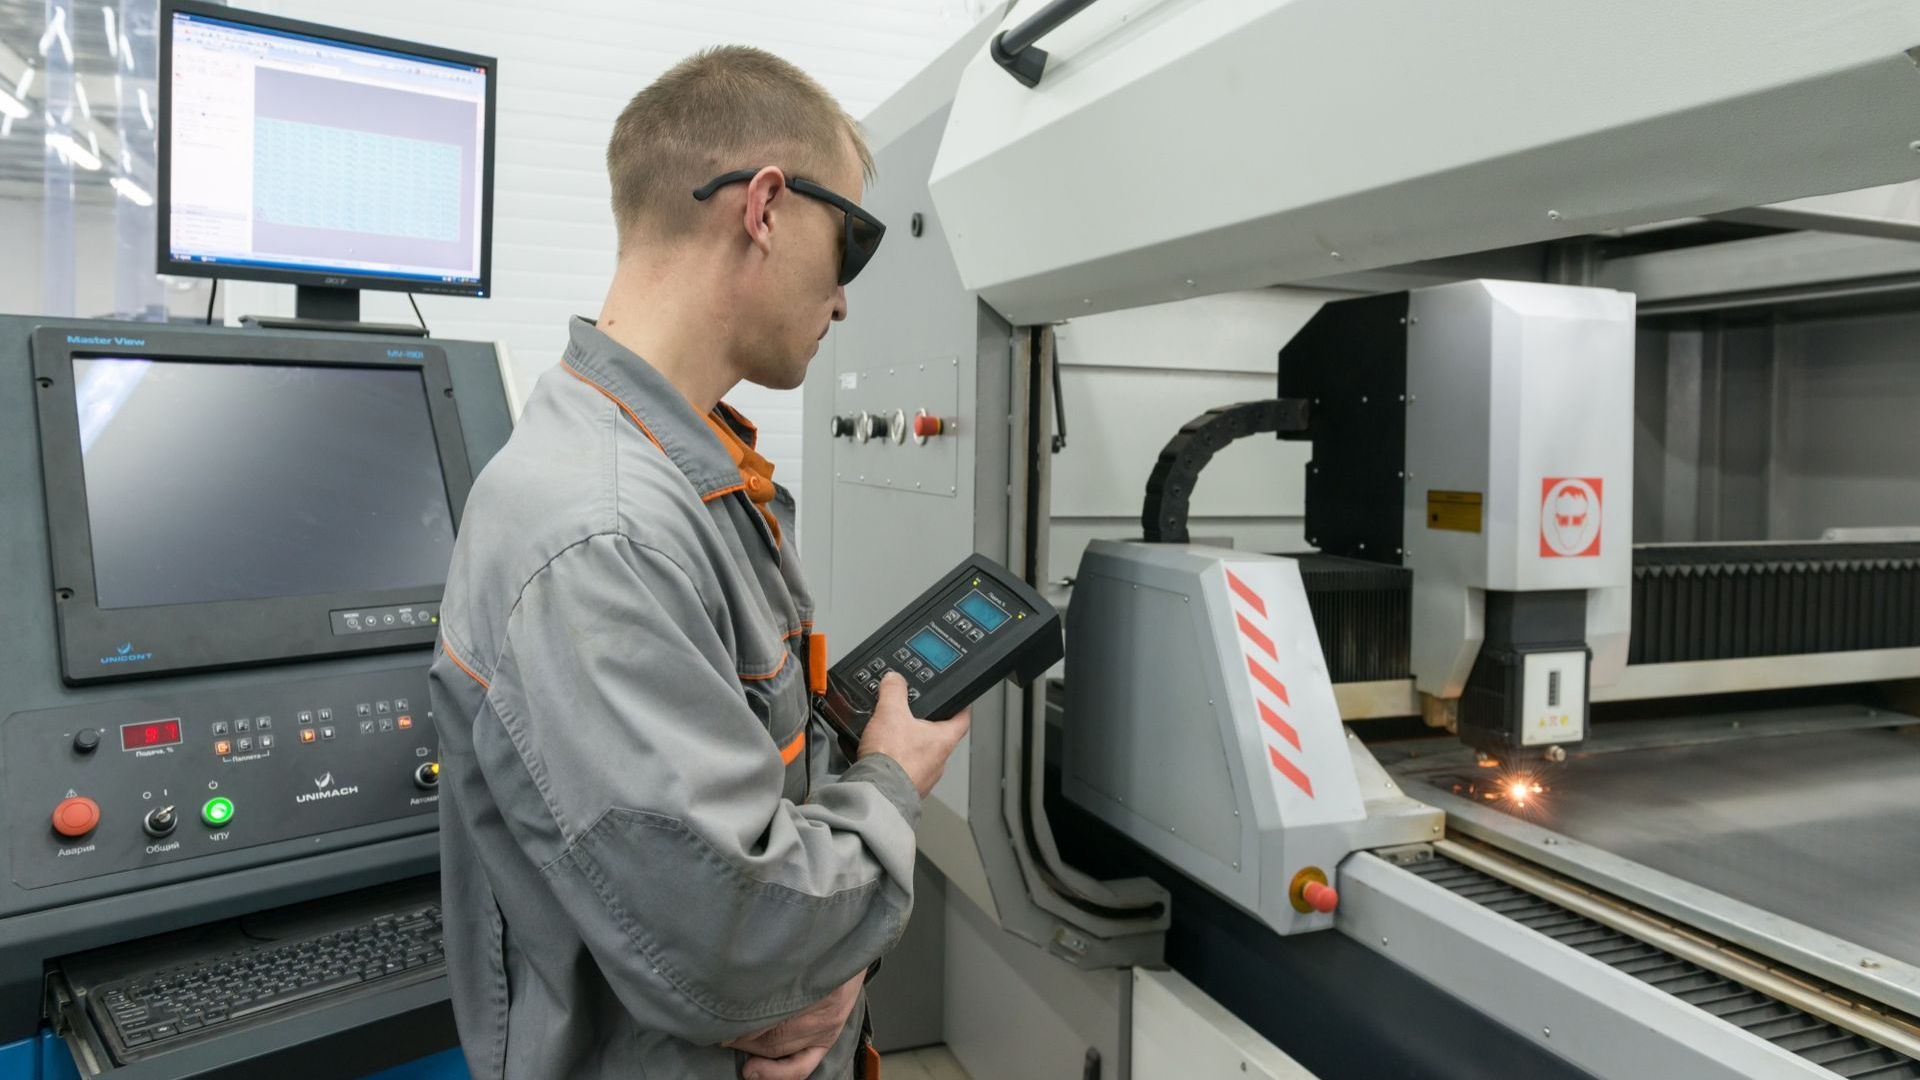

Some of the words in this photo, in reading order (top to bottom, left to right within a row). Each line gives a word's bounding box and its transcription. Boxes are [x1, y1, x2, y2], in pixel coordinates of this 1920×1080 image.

[66, 335, 112, 346] Master
[114, 337, 145, 347] View
[100, 652, 152, 664] UNICONT
[296, 785, 359, 803] UNIMACH
[209, 831, 230, 842] ЧПУ
[57, 844, 96, 857] Авария
[145, 841, 180, 855] Общий
